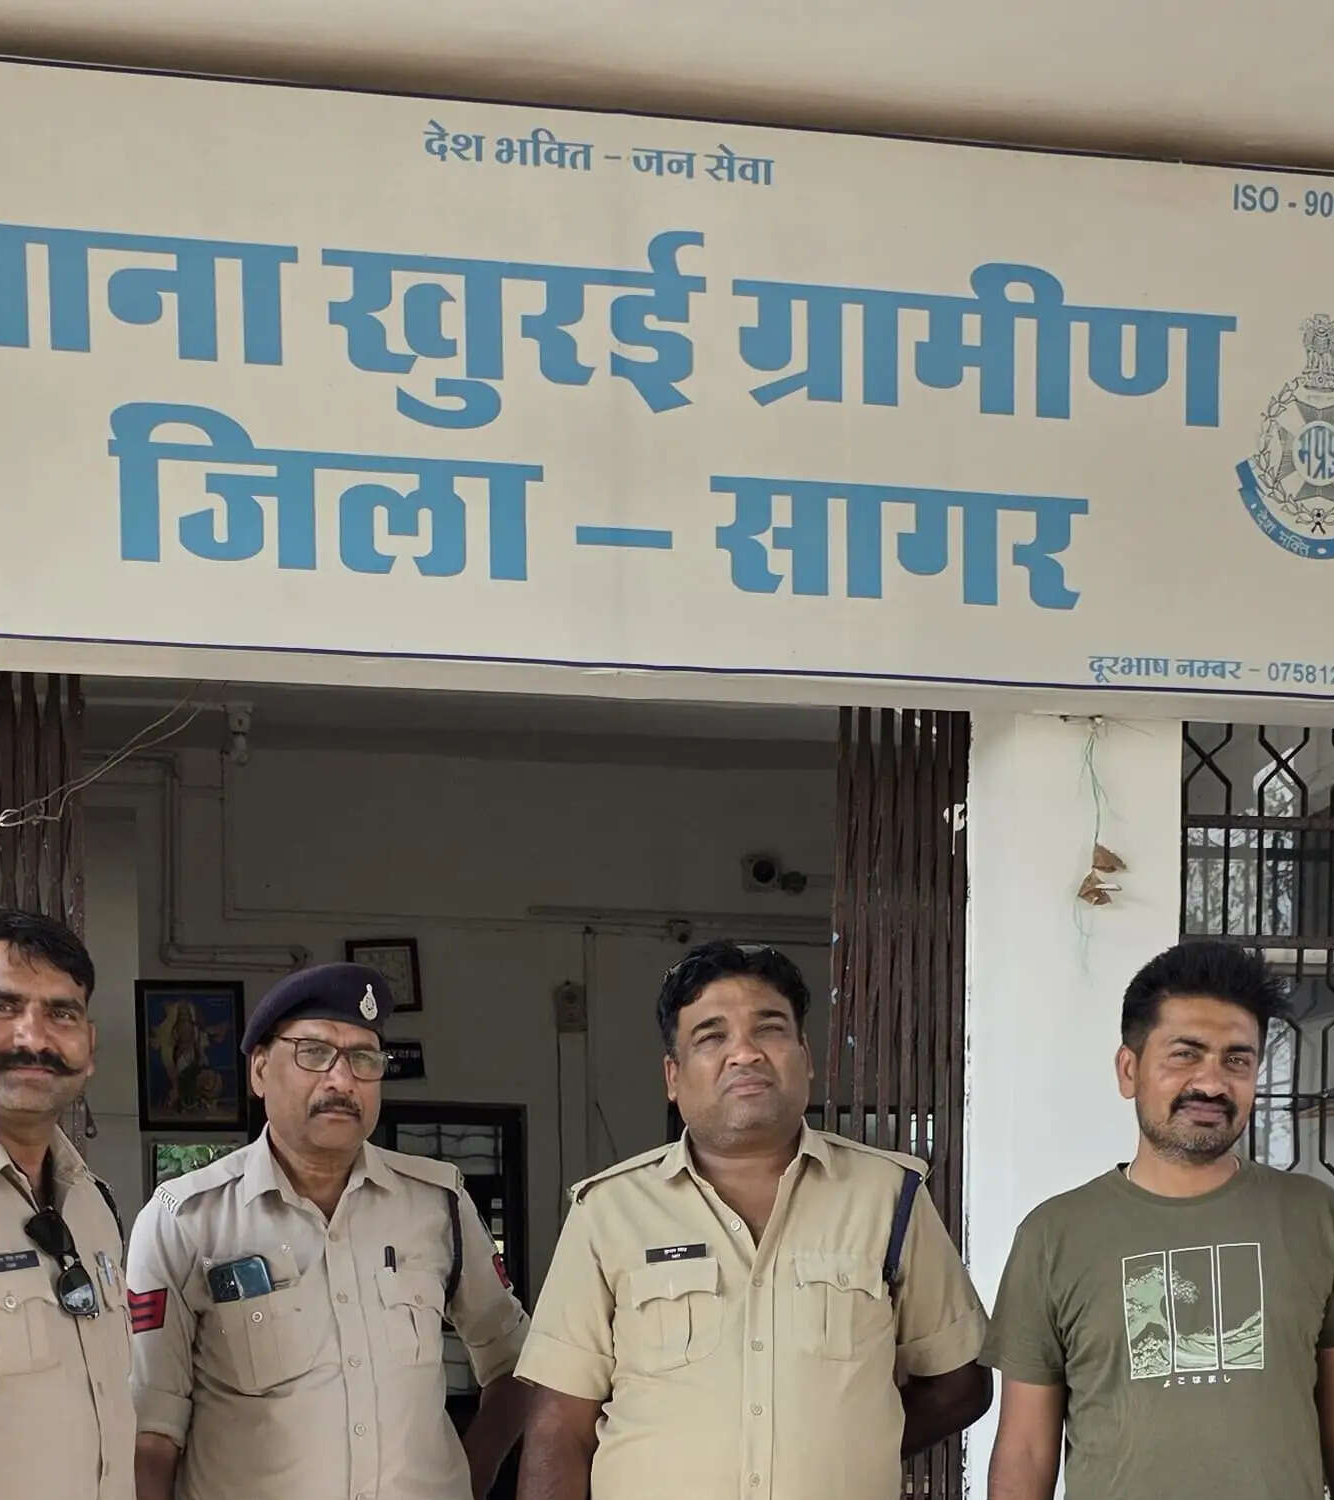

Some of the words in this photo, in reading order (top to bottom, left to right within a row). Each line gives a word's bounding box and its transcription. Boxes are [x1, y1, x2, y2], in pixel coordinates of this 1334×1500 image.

[424, 120, 483, 164] देश
[495, 126, 594, 170] भक्ति
[632, 148, 695, 181] जन
[705, 144, 774, 185] सेवा
[1233, 184, 1280, 212] ISO
[323, 230, 704, 428] खुरई
[731, 262, 1238, 425] ग्रामीण
[109, 395, 542, 580] जिला
[711, 476, 1088, 608] सागर
[1088, 655, 1170, 684] दूरभाष
[1175, 659, 1242, 681] नम्बर
